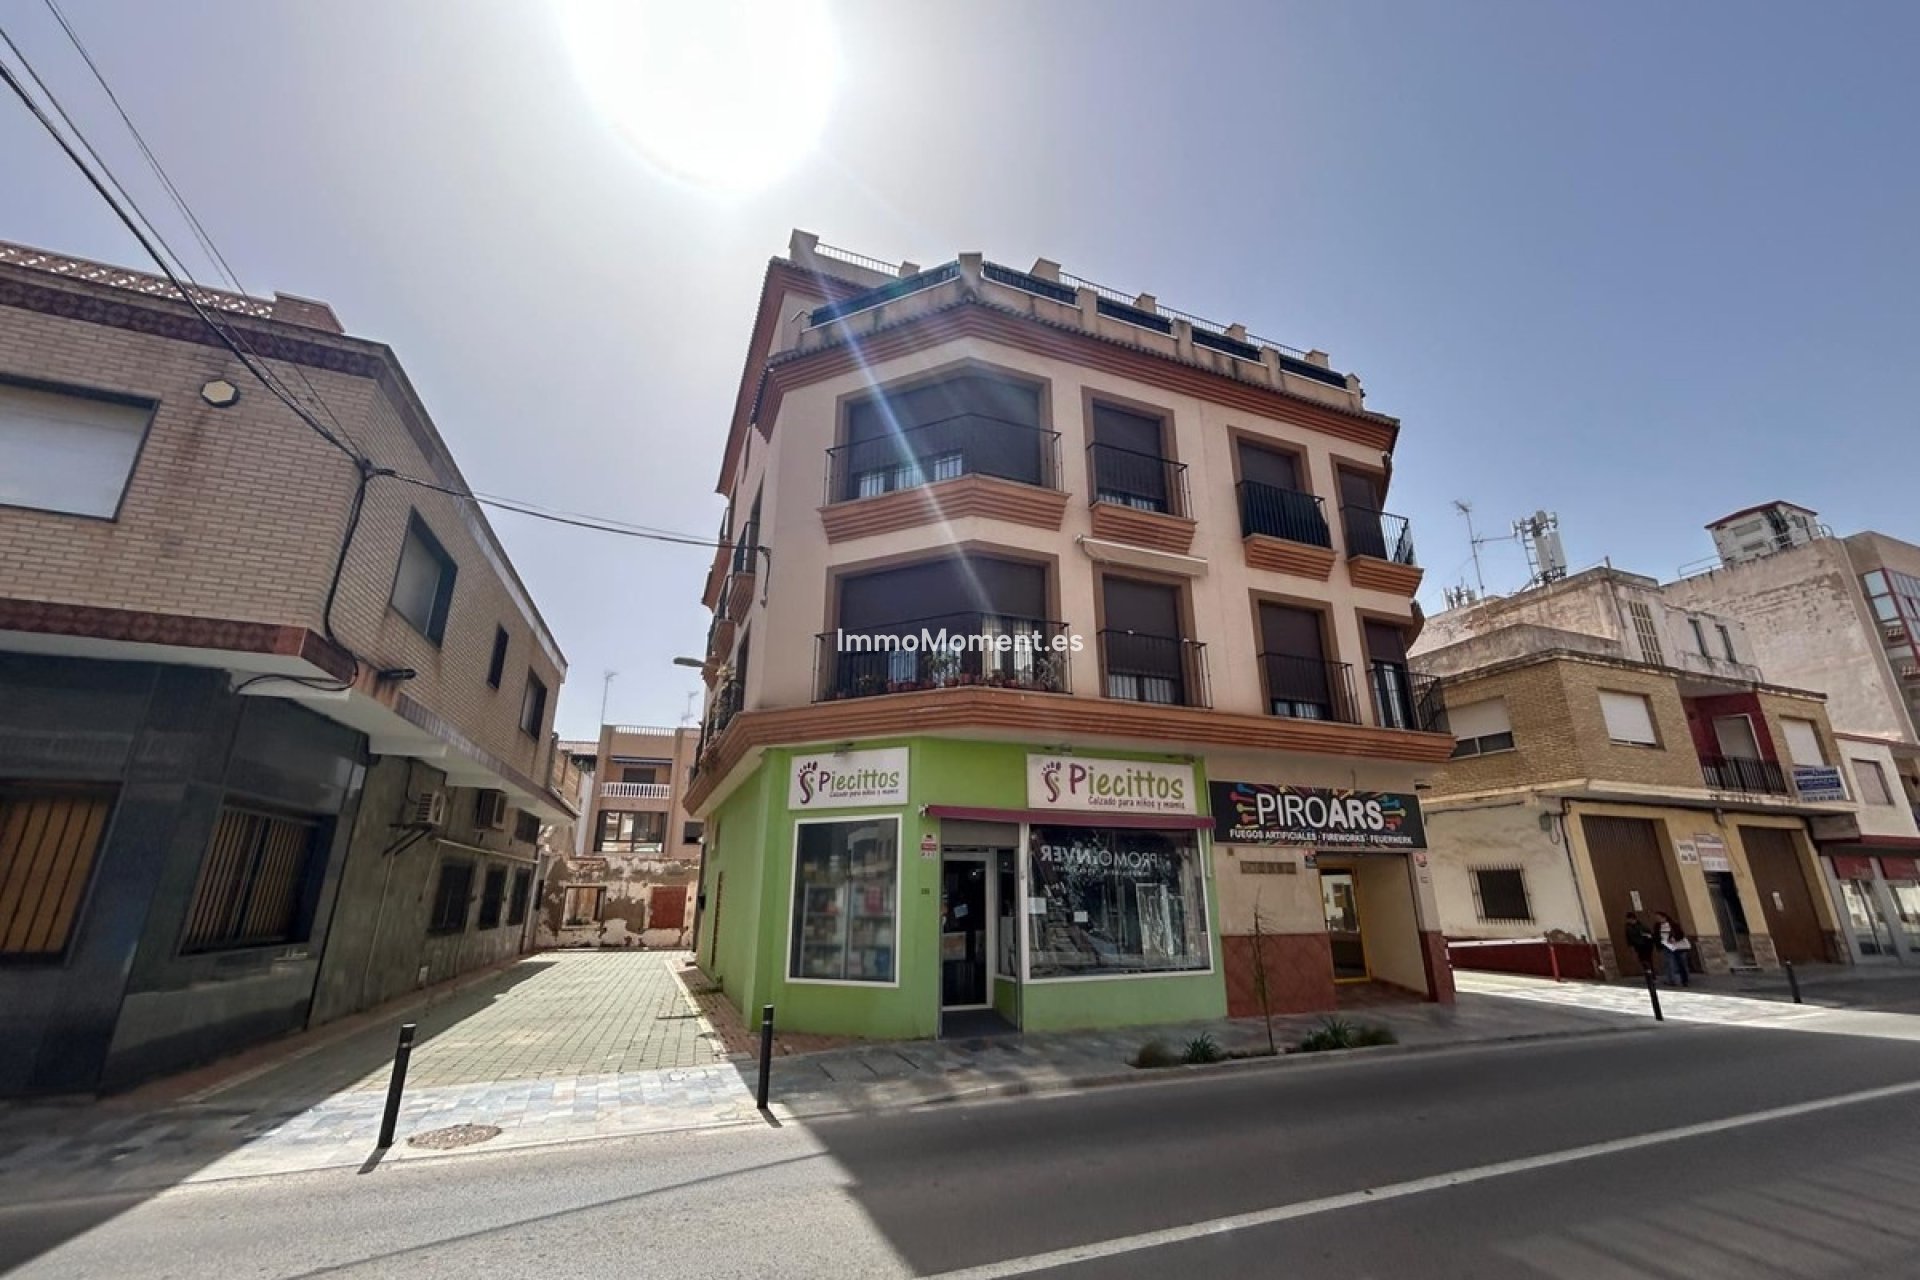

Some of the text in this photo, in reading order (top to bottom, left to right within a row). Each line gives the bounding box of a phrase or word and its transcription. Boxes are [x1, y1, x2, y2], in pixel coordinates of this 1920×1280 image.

[819, 769, 900, 792] Piecittos
[1069, 763, 1184, 800] Piecittos
[1117, 799, 1134, 808] para
[1256, 793, 1385, 831] PIROARS
[1229, 828, 1264, 839] FUEGOS
[1265, 831, 1317, 841] ARTIFICIALES
